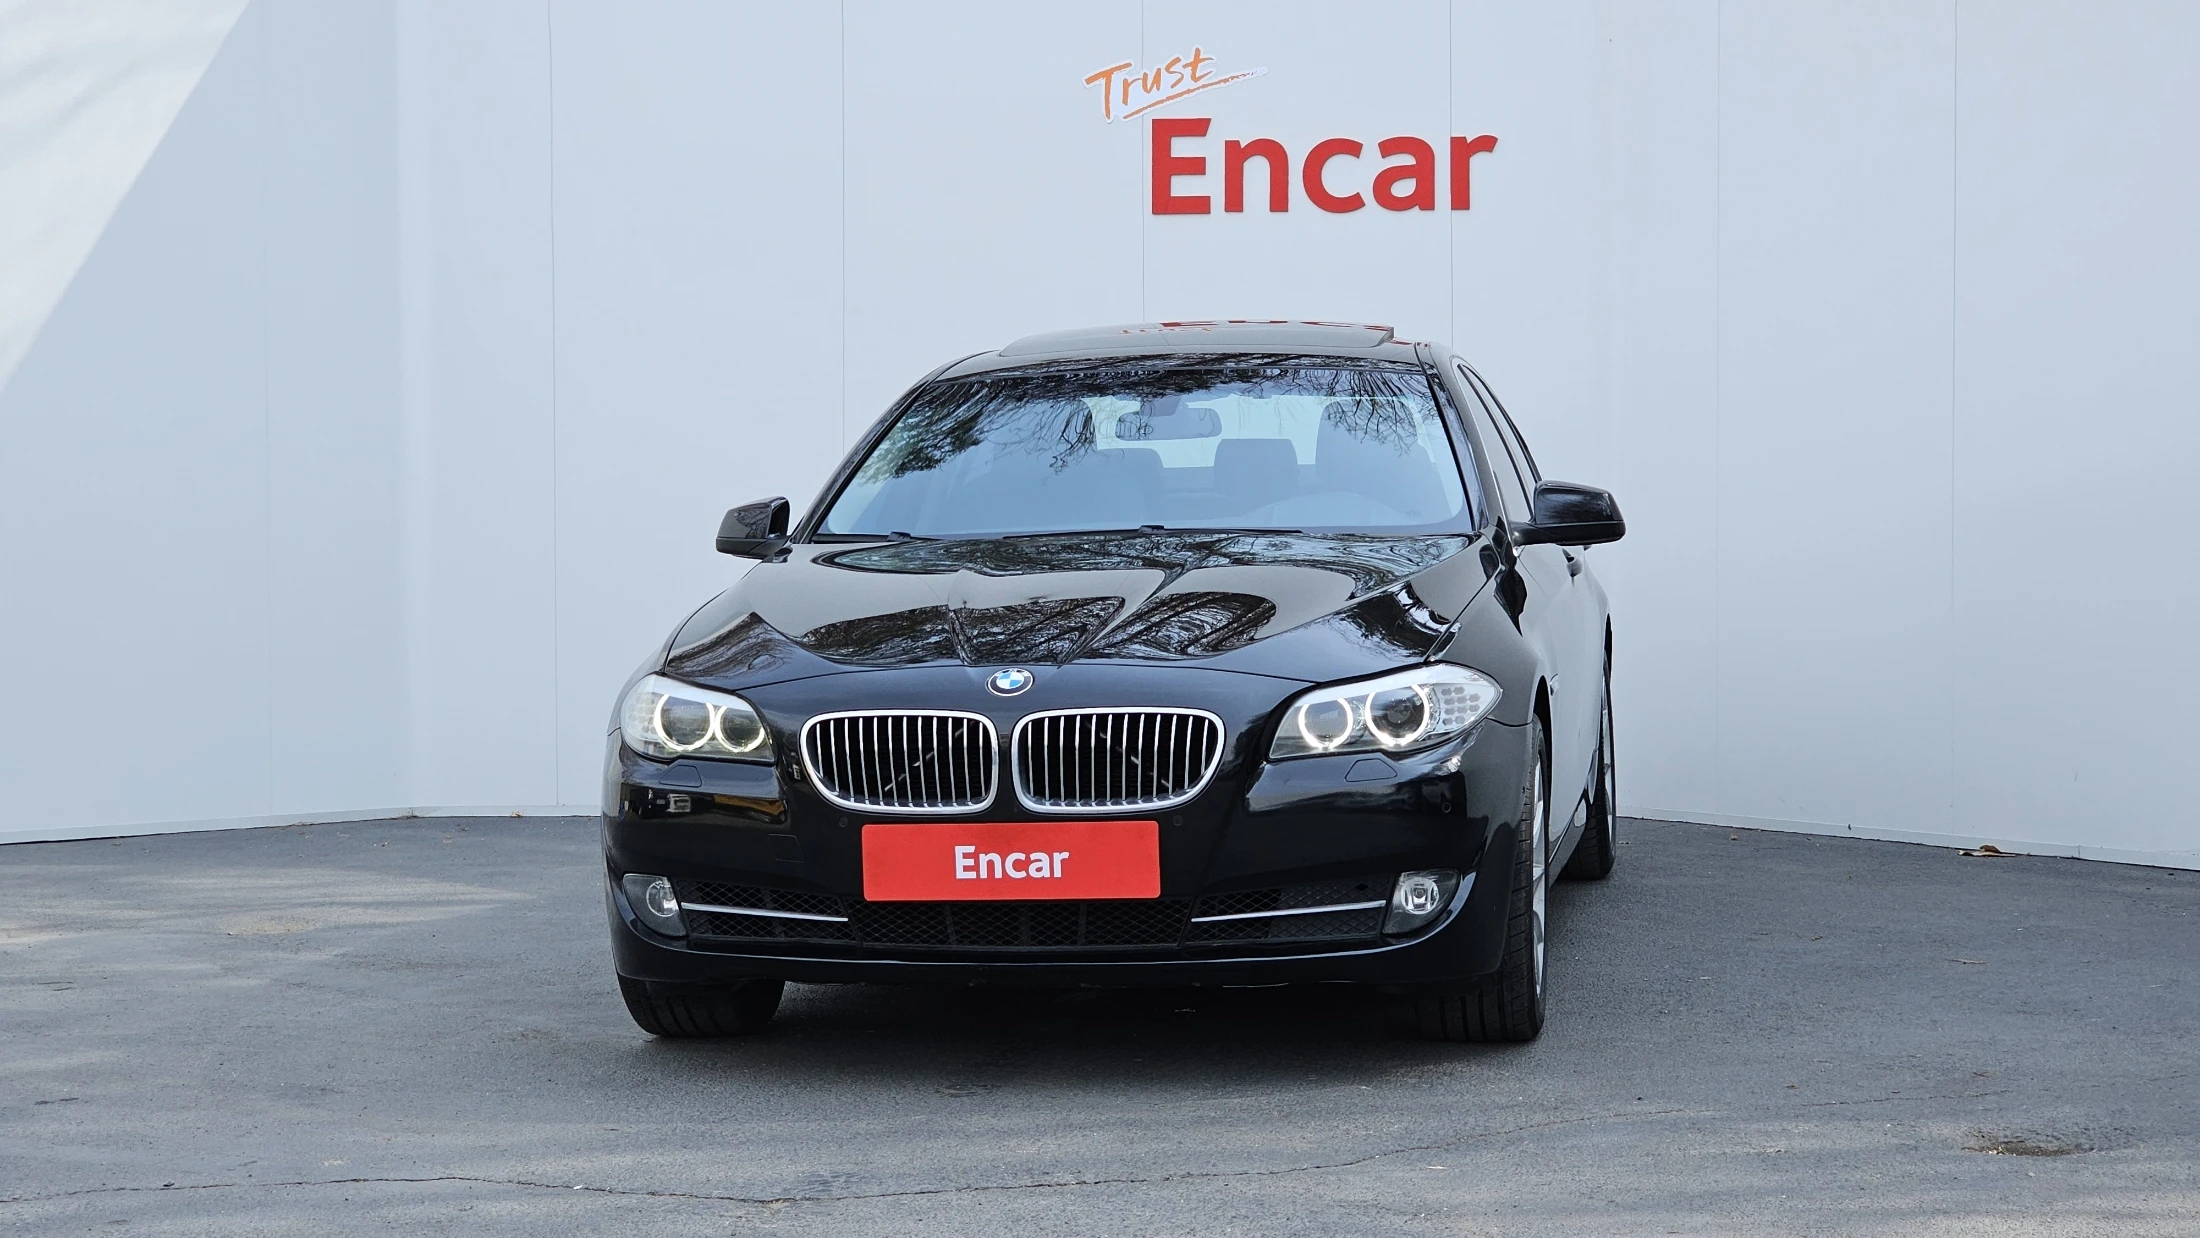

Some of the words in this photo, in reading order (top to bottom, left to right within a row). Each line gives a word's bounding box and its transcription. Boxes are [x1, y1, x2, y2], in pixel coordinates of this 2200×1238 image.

[1084, 47, 1215, 119] Trust
[1151, 117, 1498, 215] Encar
[954, 845, 1070, 880] Encar
